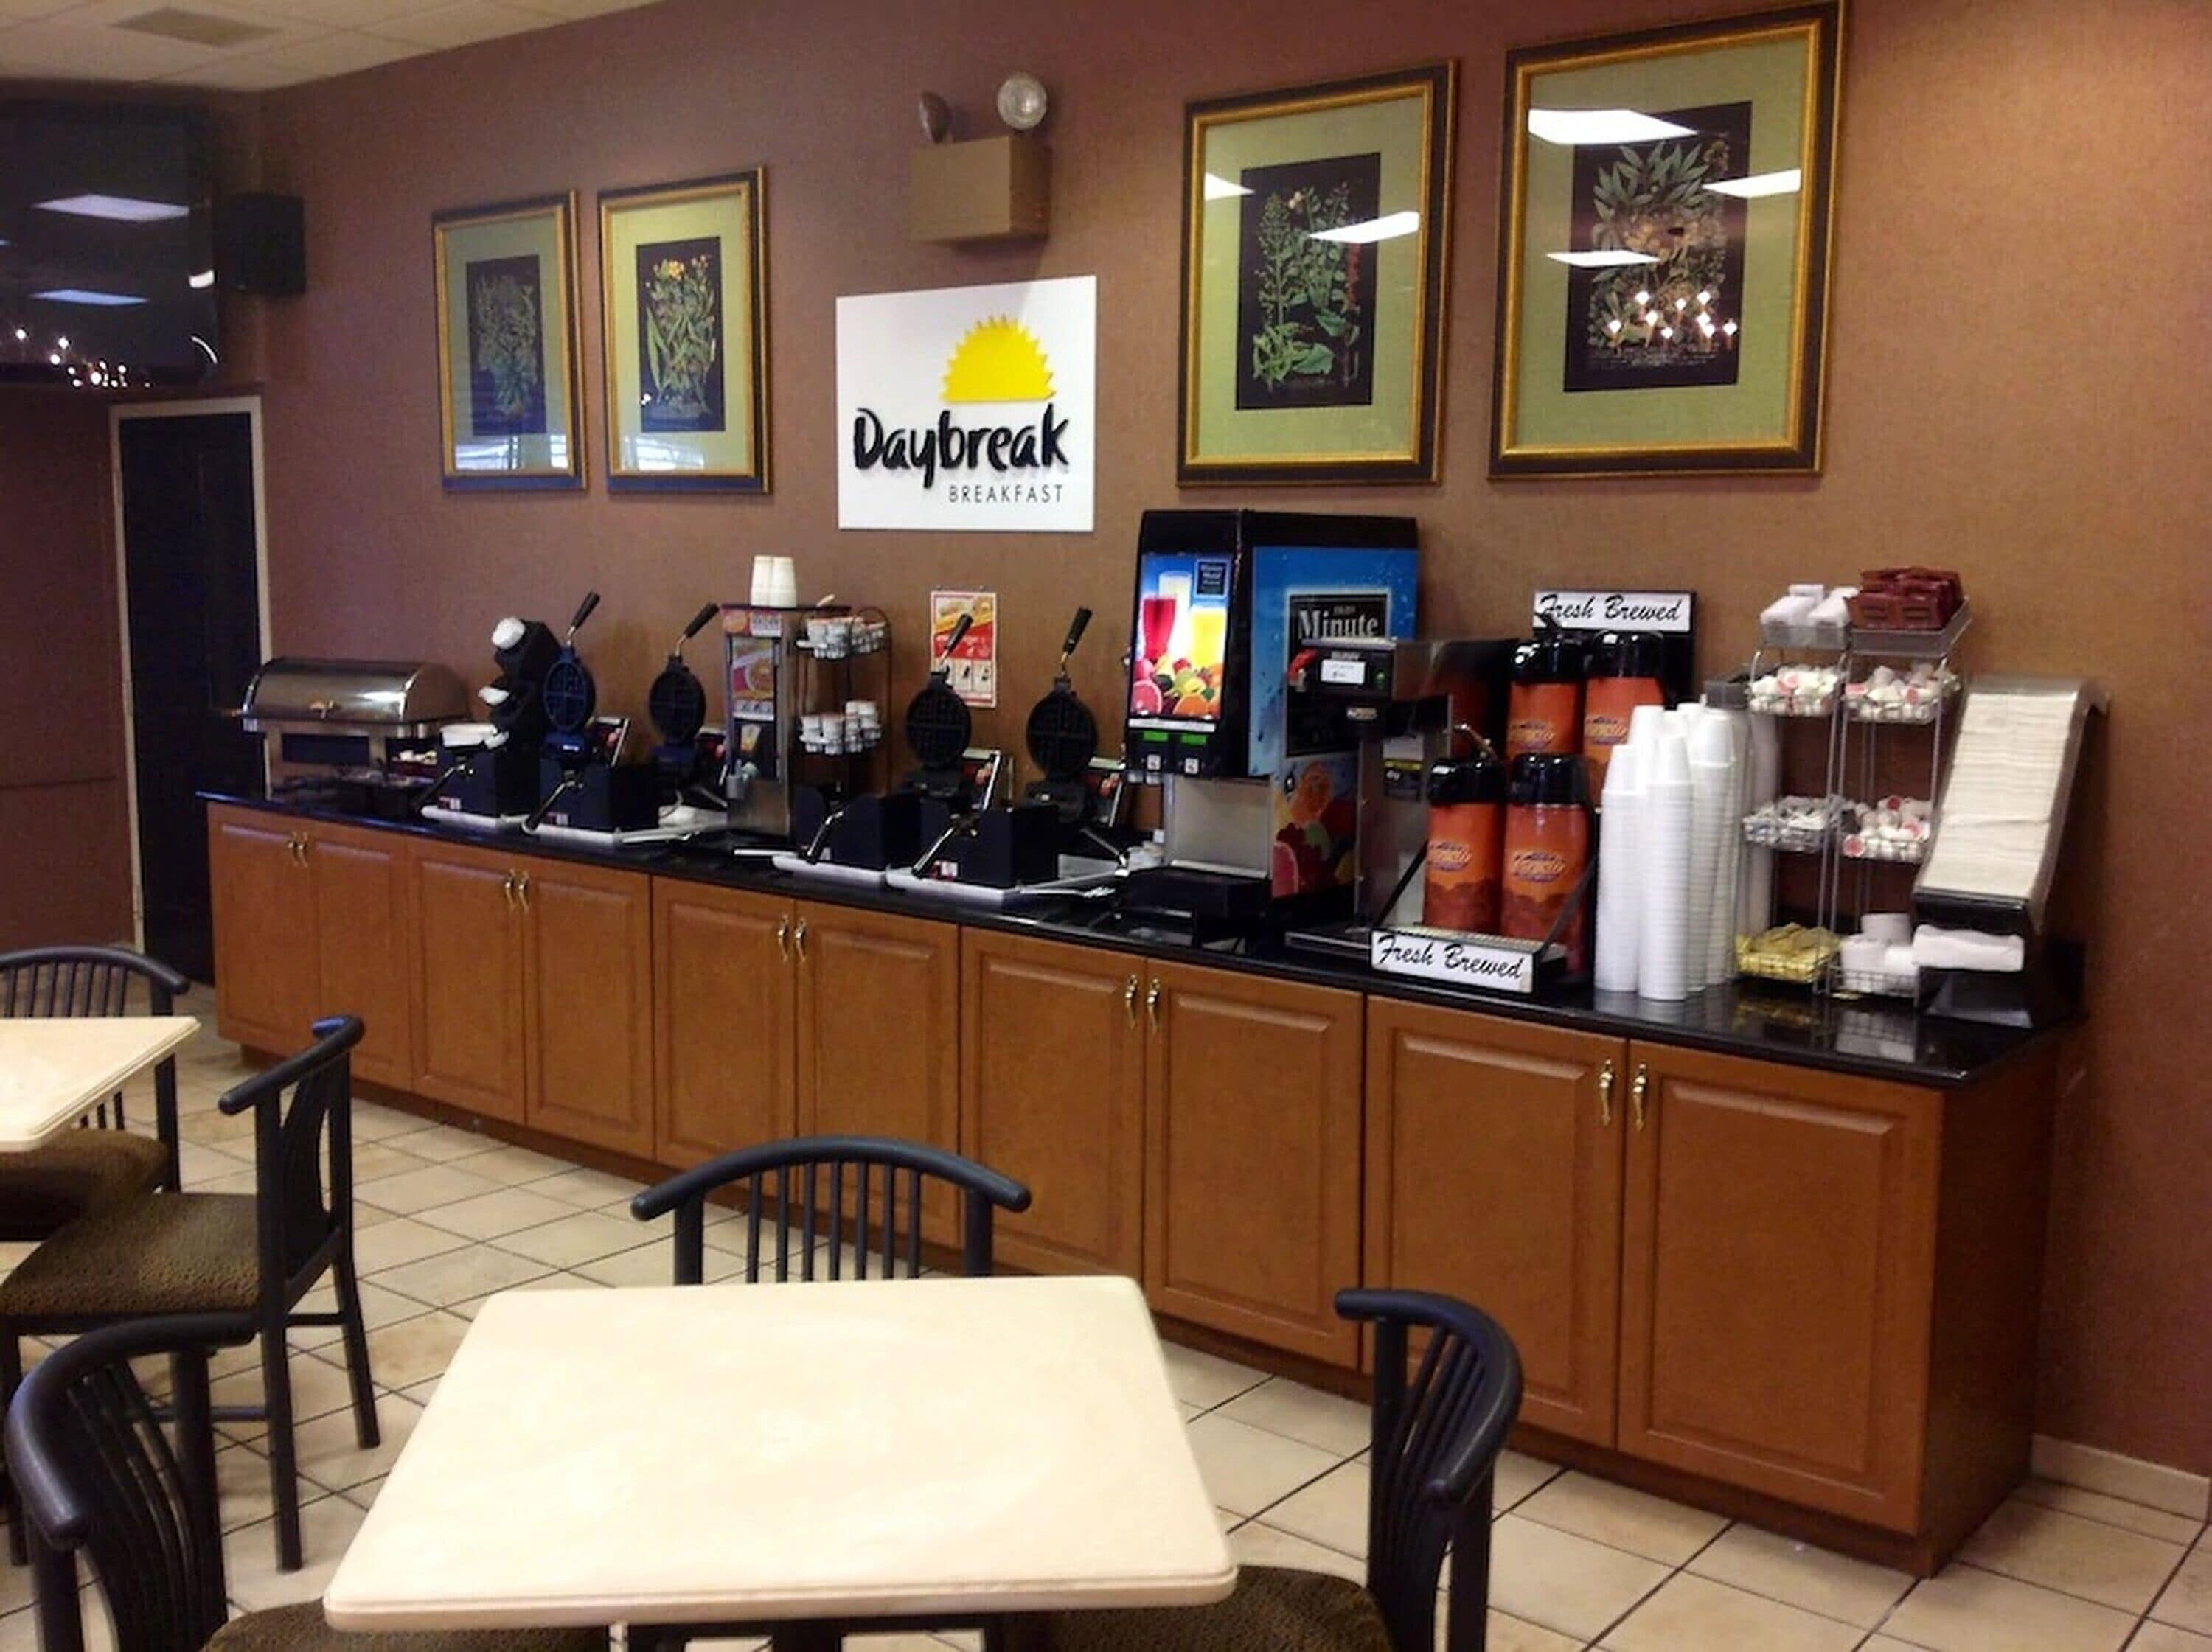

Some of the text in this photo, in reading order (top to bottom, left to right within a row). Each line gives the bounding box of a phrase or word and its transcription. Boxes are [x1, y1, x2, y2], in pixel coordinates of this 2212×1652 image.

[854, 403, 1069, 489] Daybreak
[948, 484, 1063, 503] BREAKFAST
[1540, 594, 1682, 620] Fresh Brewed
[1298, 610, 1378, 639] Minute
[1378, 934, 1523, 979] Fresh Brewed
